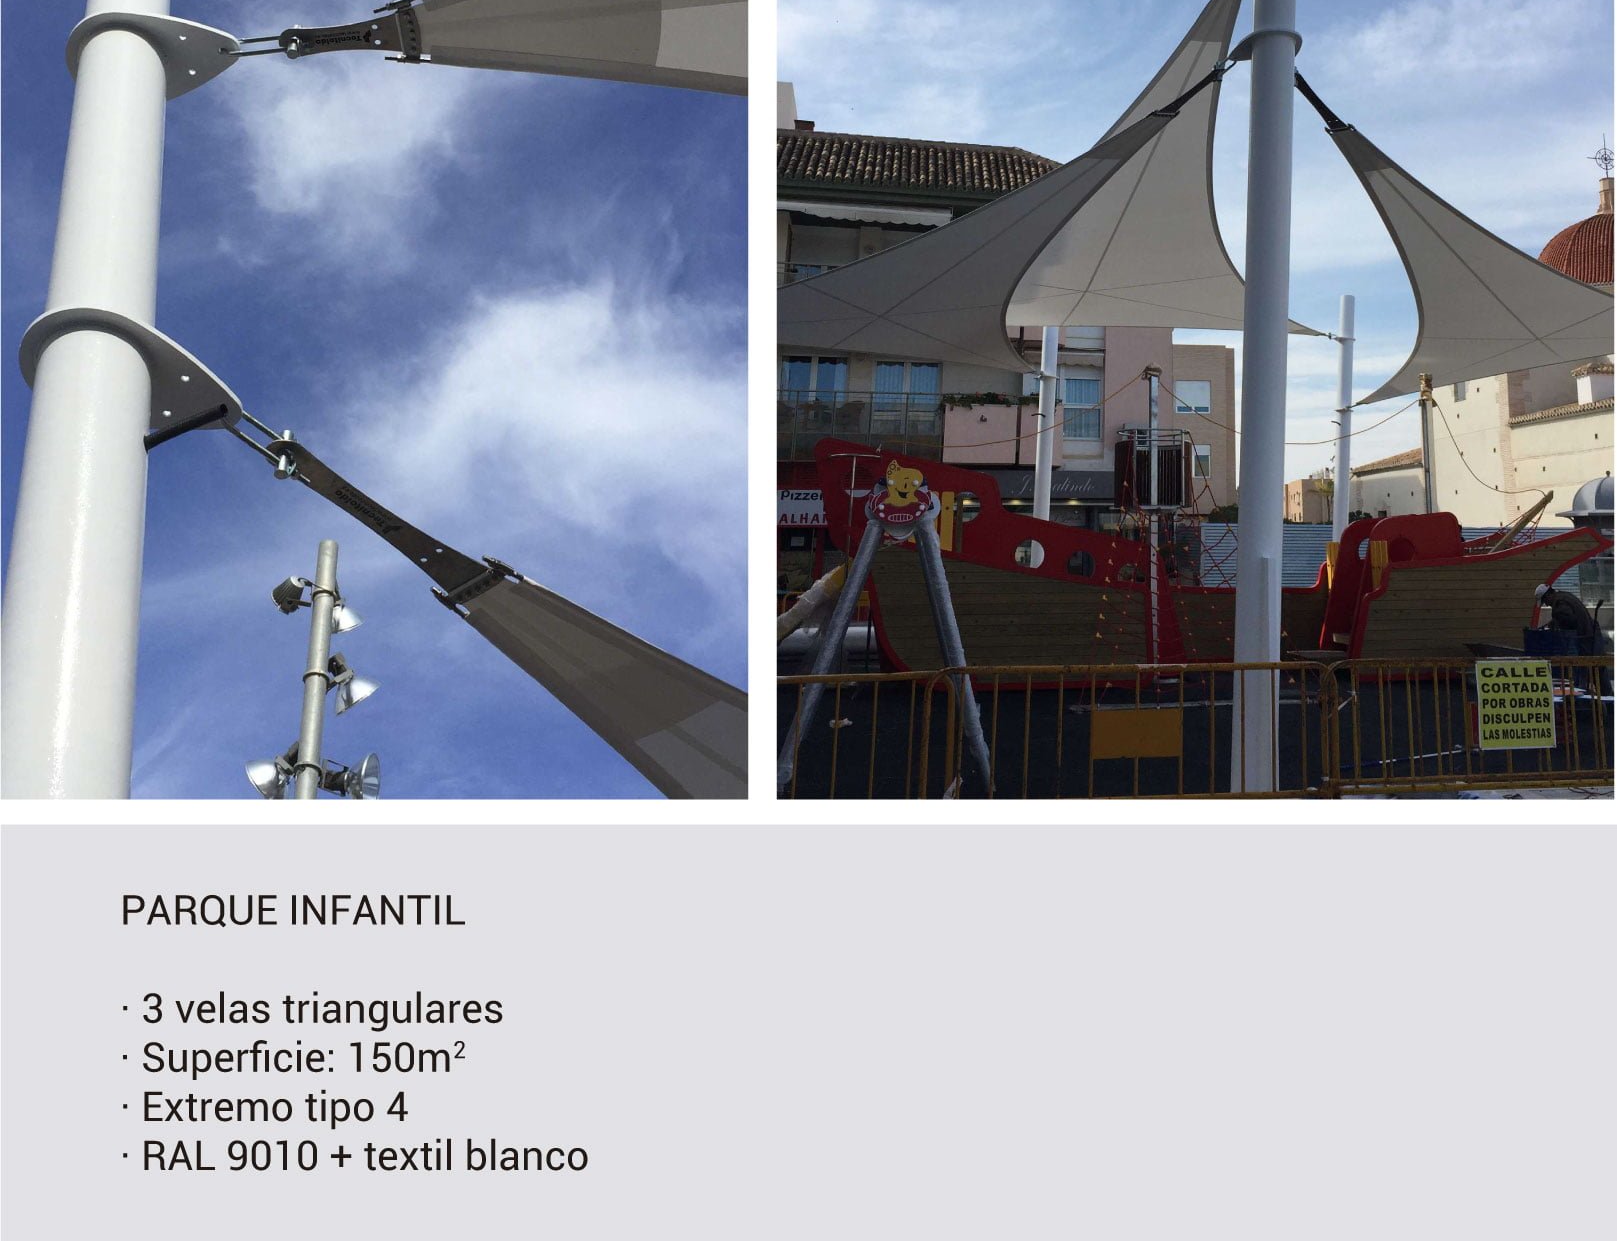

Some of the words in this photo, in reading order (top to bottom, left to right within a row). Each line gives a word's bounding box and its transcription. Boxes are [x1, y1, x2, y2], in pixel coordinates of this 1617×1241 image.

[1051, 476, 1096, 492] alindo
[1481, 667, 1547, 678] CALLE
[1481, 682, 1550, 694] CORTADA
[1482, 698, 1507, 709] POR
[1509, 697, 1550, 709] OBRAS
[1482, 712, 1551, 725] DISCULPEN
[1483, 729, 1500, 740] LAS
[1502, 727, 1552, 740] MOLESTIAS
